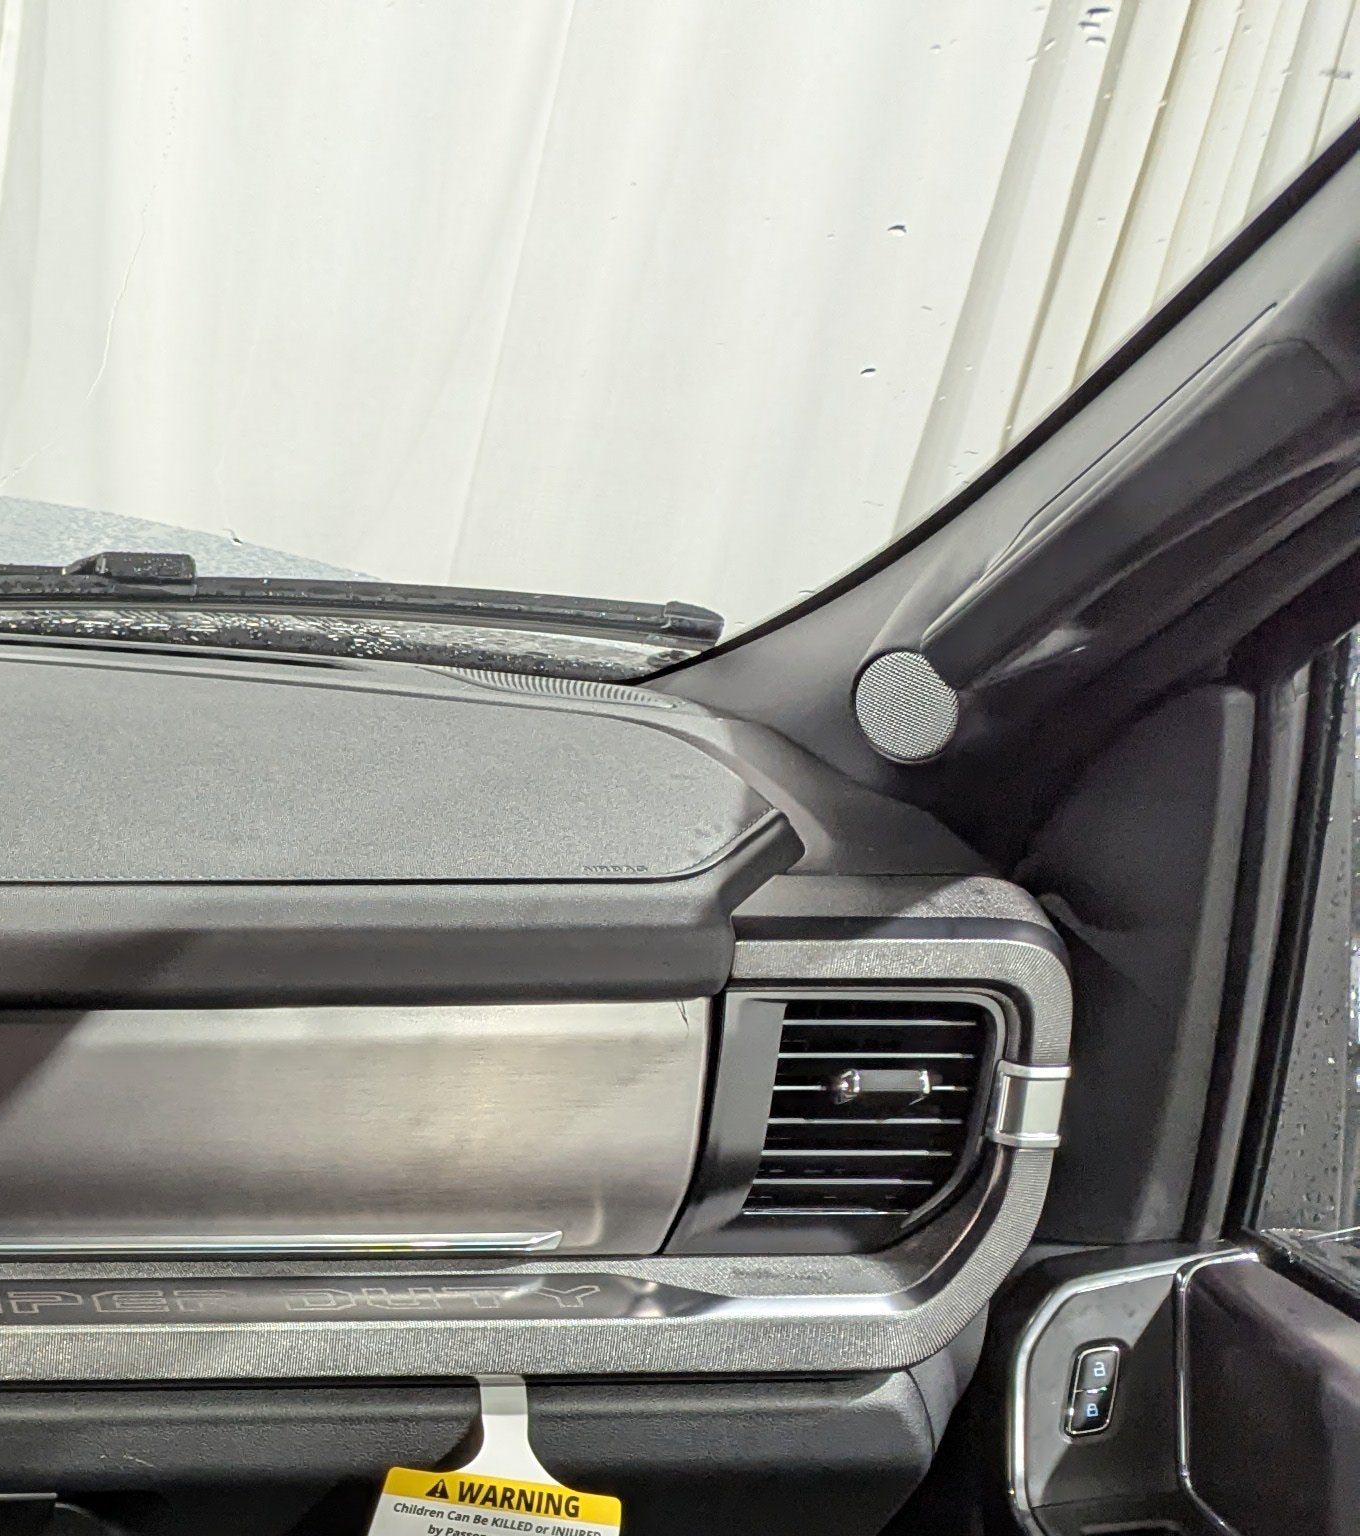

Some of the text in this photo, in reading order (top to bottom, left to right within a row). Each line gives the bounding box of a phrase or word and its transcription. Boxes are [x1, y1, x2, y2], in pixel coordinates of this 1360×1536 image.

[282, 1285, 600, 1311] DUTY
[458, 1481, 580, 1518] WARNING
[394, 1502, 443, 1519] Children
[447, 1510, 470, 1523] Can
[473, 1514, 488, 1526] Be
[491, 1517, 533, 1532] KILLED
[535, 1525, 549, 1534] or
